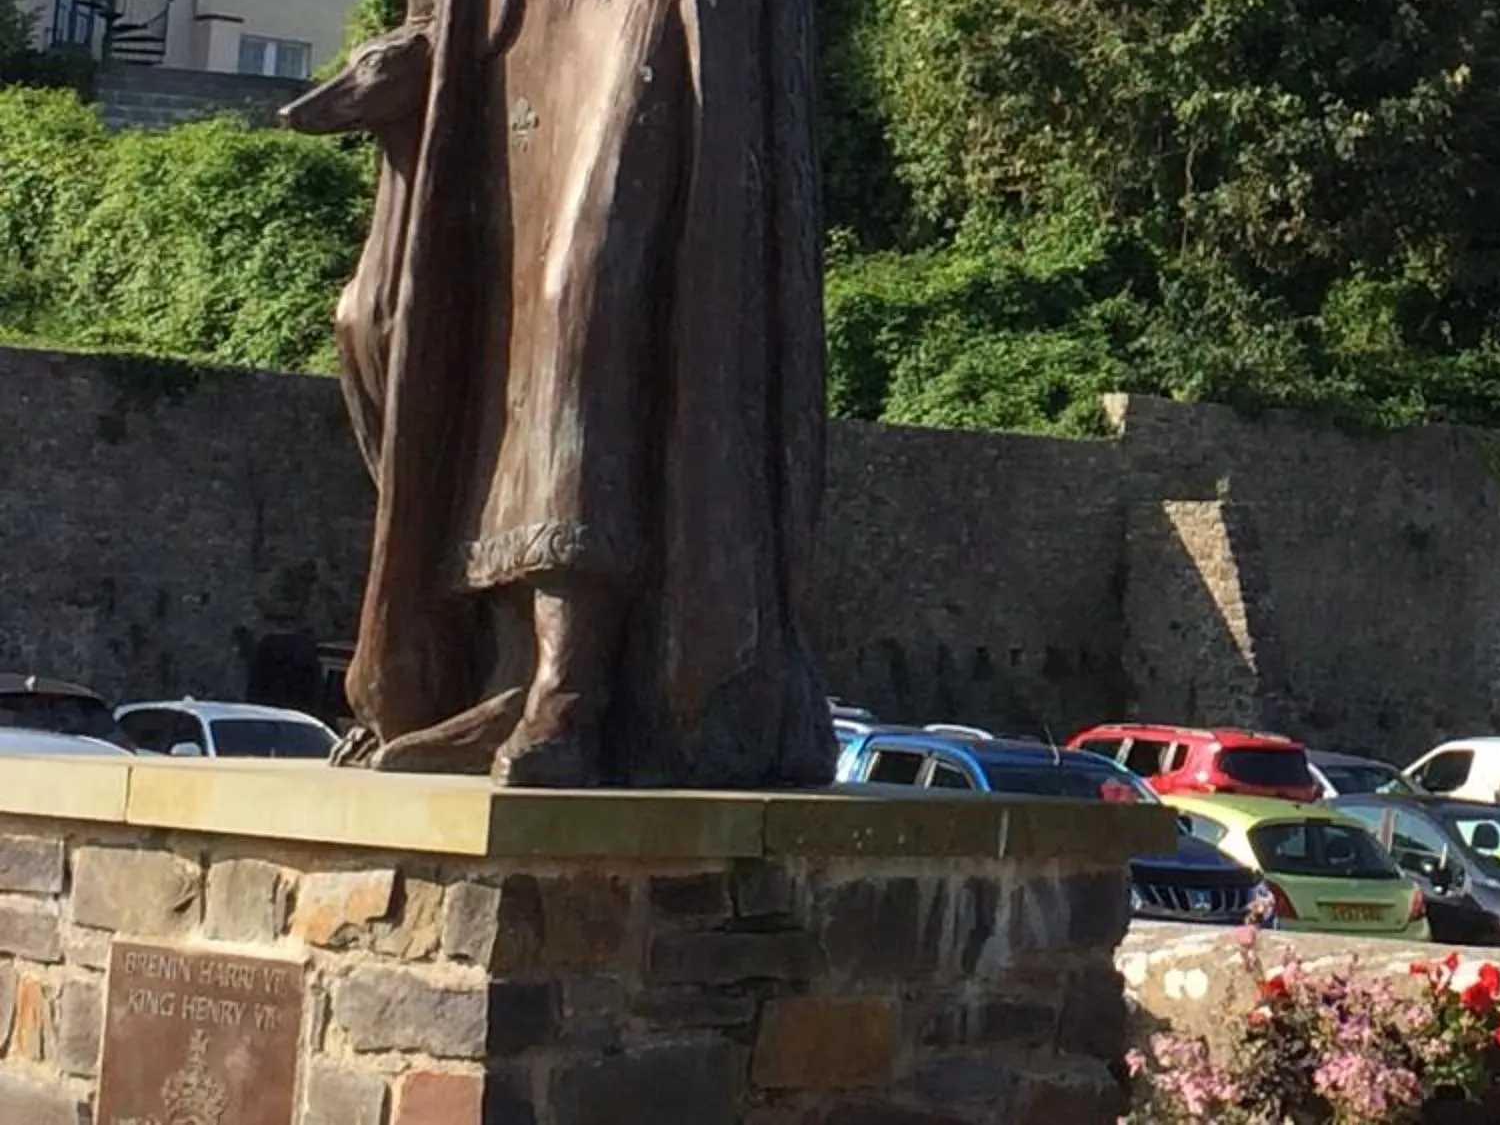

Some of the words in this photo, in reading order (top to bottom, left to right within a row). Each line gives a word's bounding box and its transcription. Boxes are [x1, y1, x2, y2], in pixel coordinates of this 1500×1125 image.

[125, 951, 193, 982] BRENIN
[129, 988, 177, 1017] KING
[182, 995, 247, 1026] HENRY
